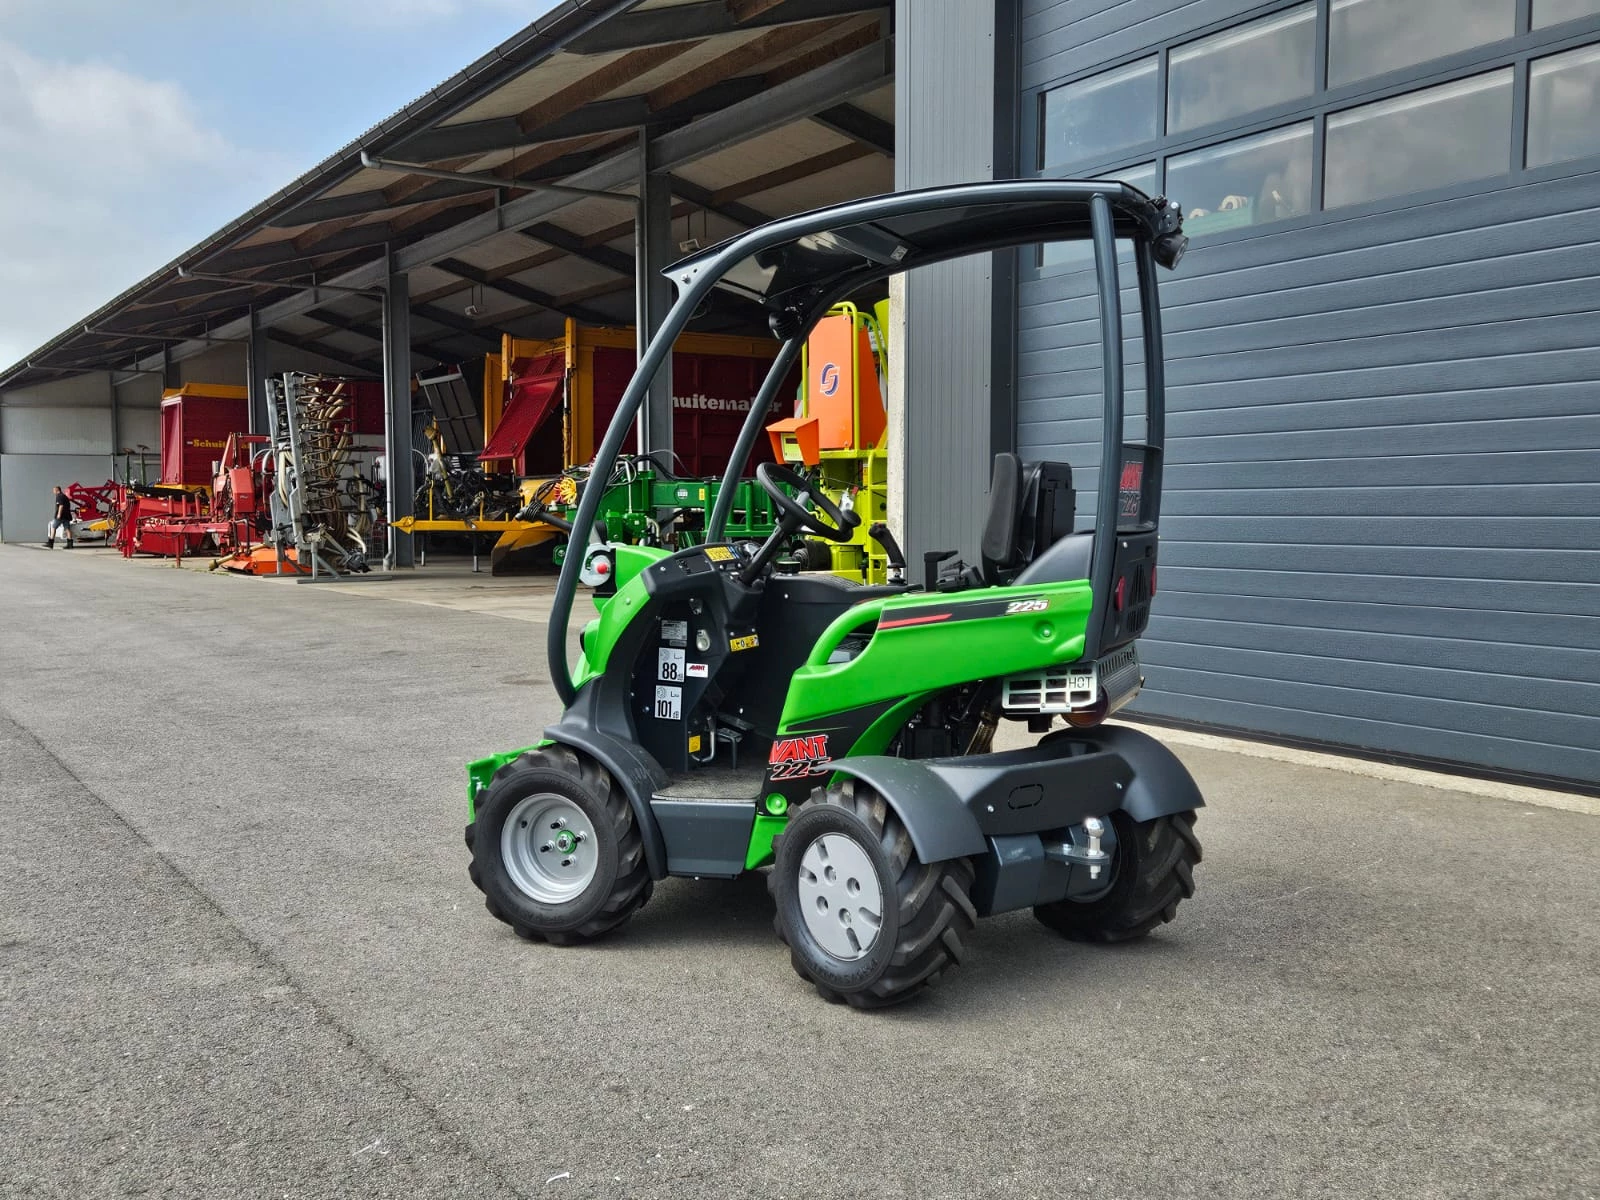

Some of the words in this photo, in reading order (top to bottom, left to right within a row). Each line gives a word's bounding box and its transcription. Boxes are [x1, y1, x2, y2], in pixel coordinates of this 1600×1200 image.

[672, 393, 782, 413] uitemar
[1007, 600, 1049, 613] 225
[662, 662, 677, 680] 88
[1068, 676, 1093, 689] HOT
[657, 699, 672, 718] 101
[769, 735, 828, 763] VANT
[770, 757, 832, 782] 225
